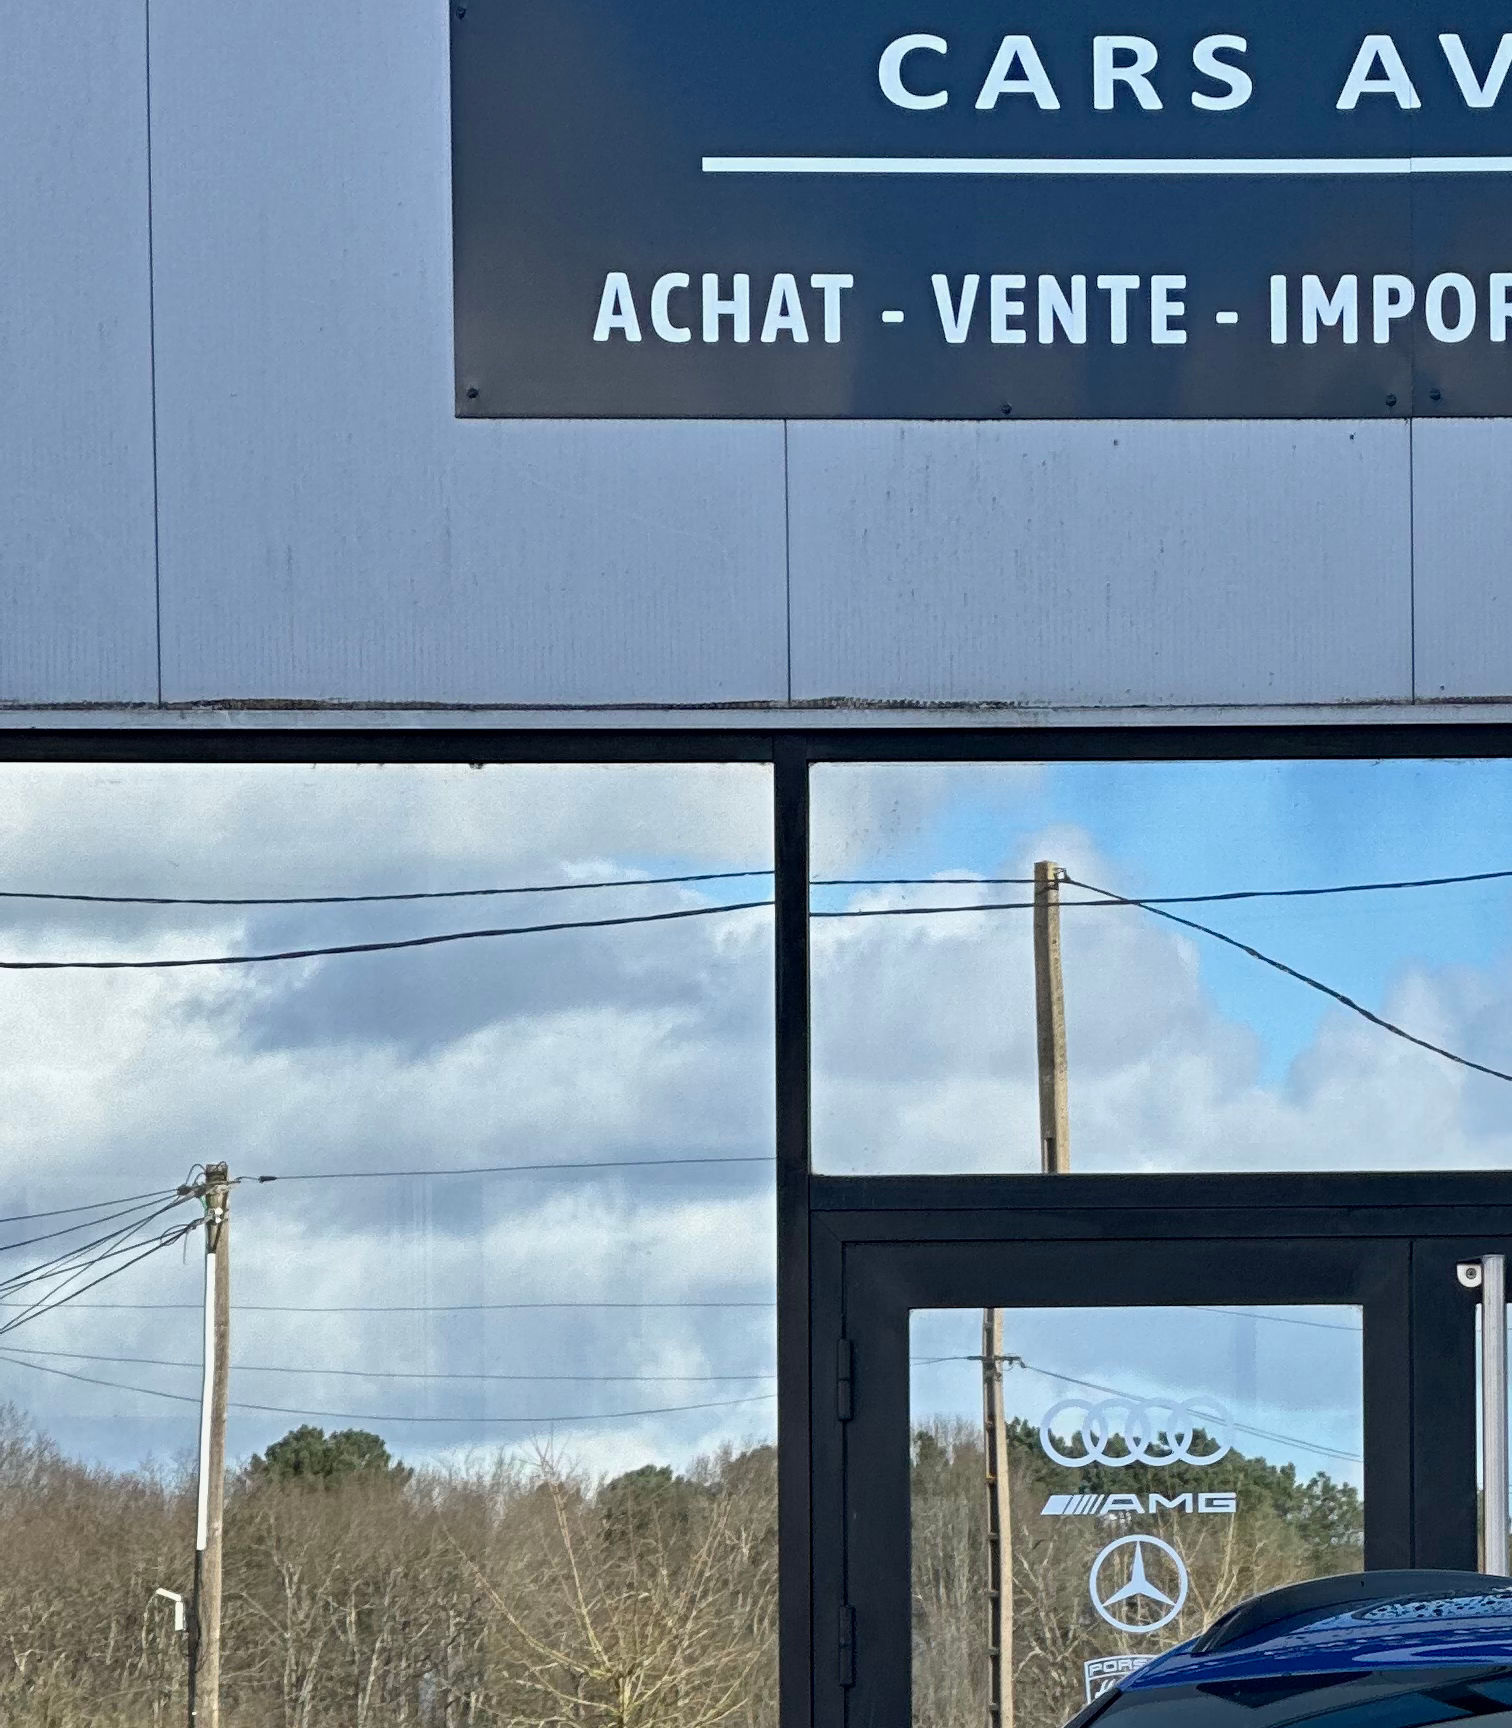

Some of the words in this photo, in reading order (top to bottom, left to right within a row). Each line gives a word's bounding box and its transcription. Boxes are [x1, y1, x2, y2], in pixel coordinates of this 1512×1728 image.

[878, 33, 1254, 111] CARS
[592, 272, 855, 344] ACHAT
[931, 273, 1188, 344] VENTE
[1099, 1492, 1237, 1515] AMG
[1089, 1658, 1150, 1677] PORS
